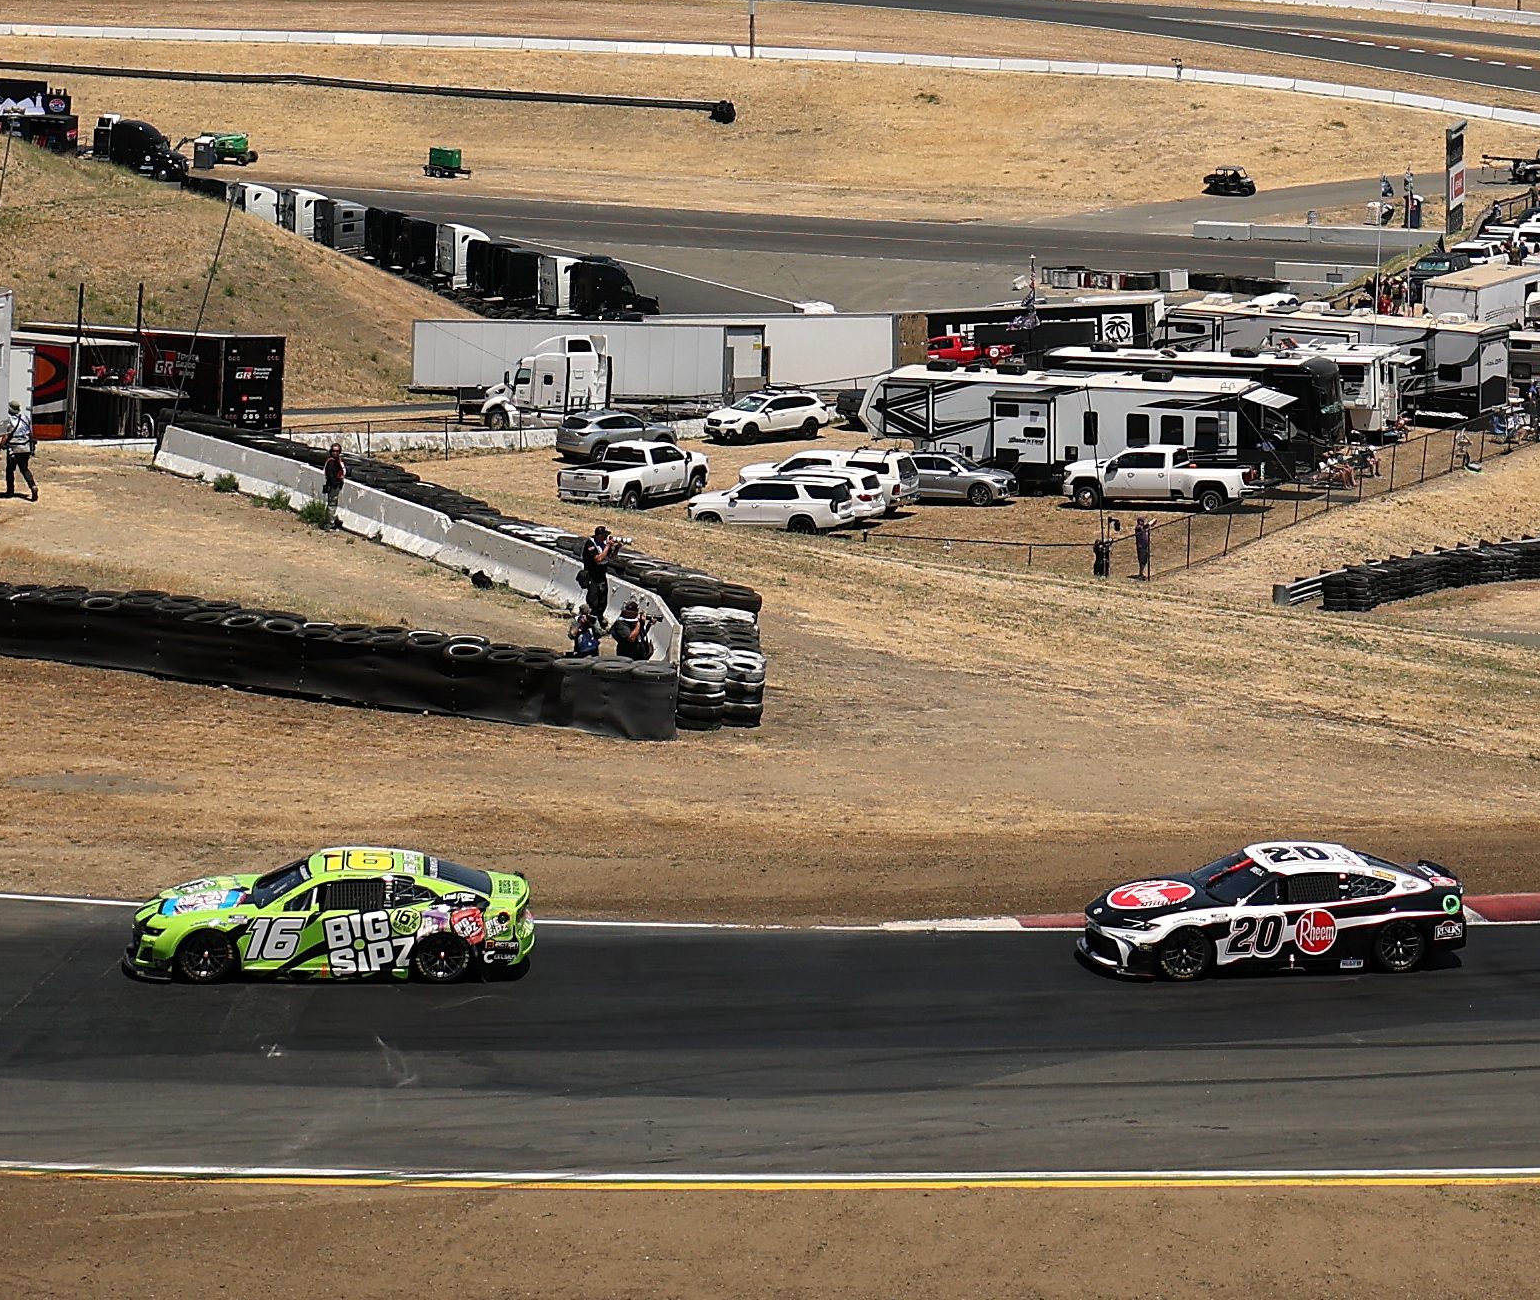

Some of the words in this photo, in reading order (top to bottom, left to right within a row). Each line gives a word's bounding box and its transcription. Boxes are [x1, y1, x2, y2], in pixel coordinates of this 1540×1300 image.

[155, 360, 174, 375] GR
[235, 371, 252, 380] GR
[324, 849, 395, 871] 16
[1261, 846, 1331, 863] 20
[245, 916, 307, 961] 16
[324, 909, 391, 950] BIG
[1226, 913, 1285, 956] 20
[1300, 911, 1335, 947] Rheem
